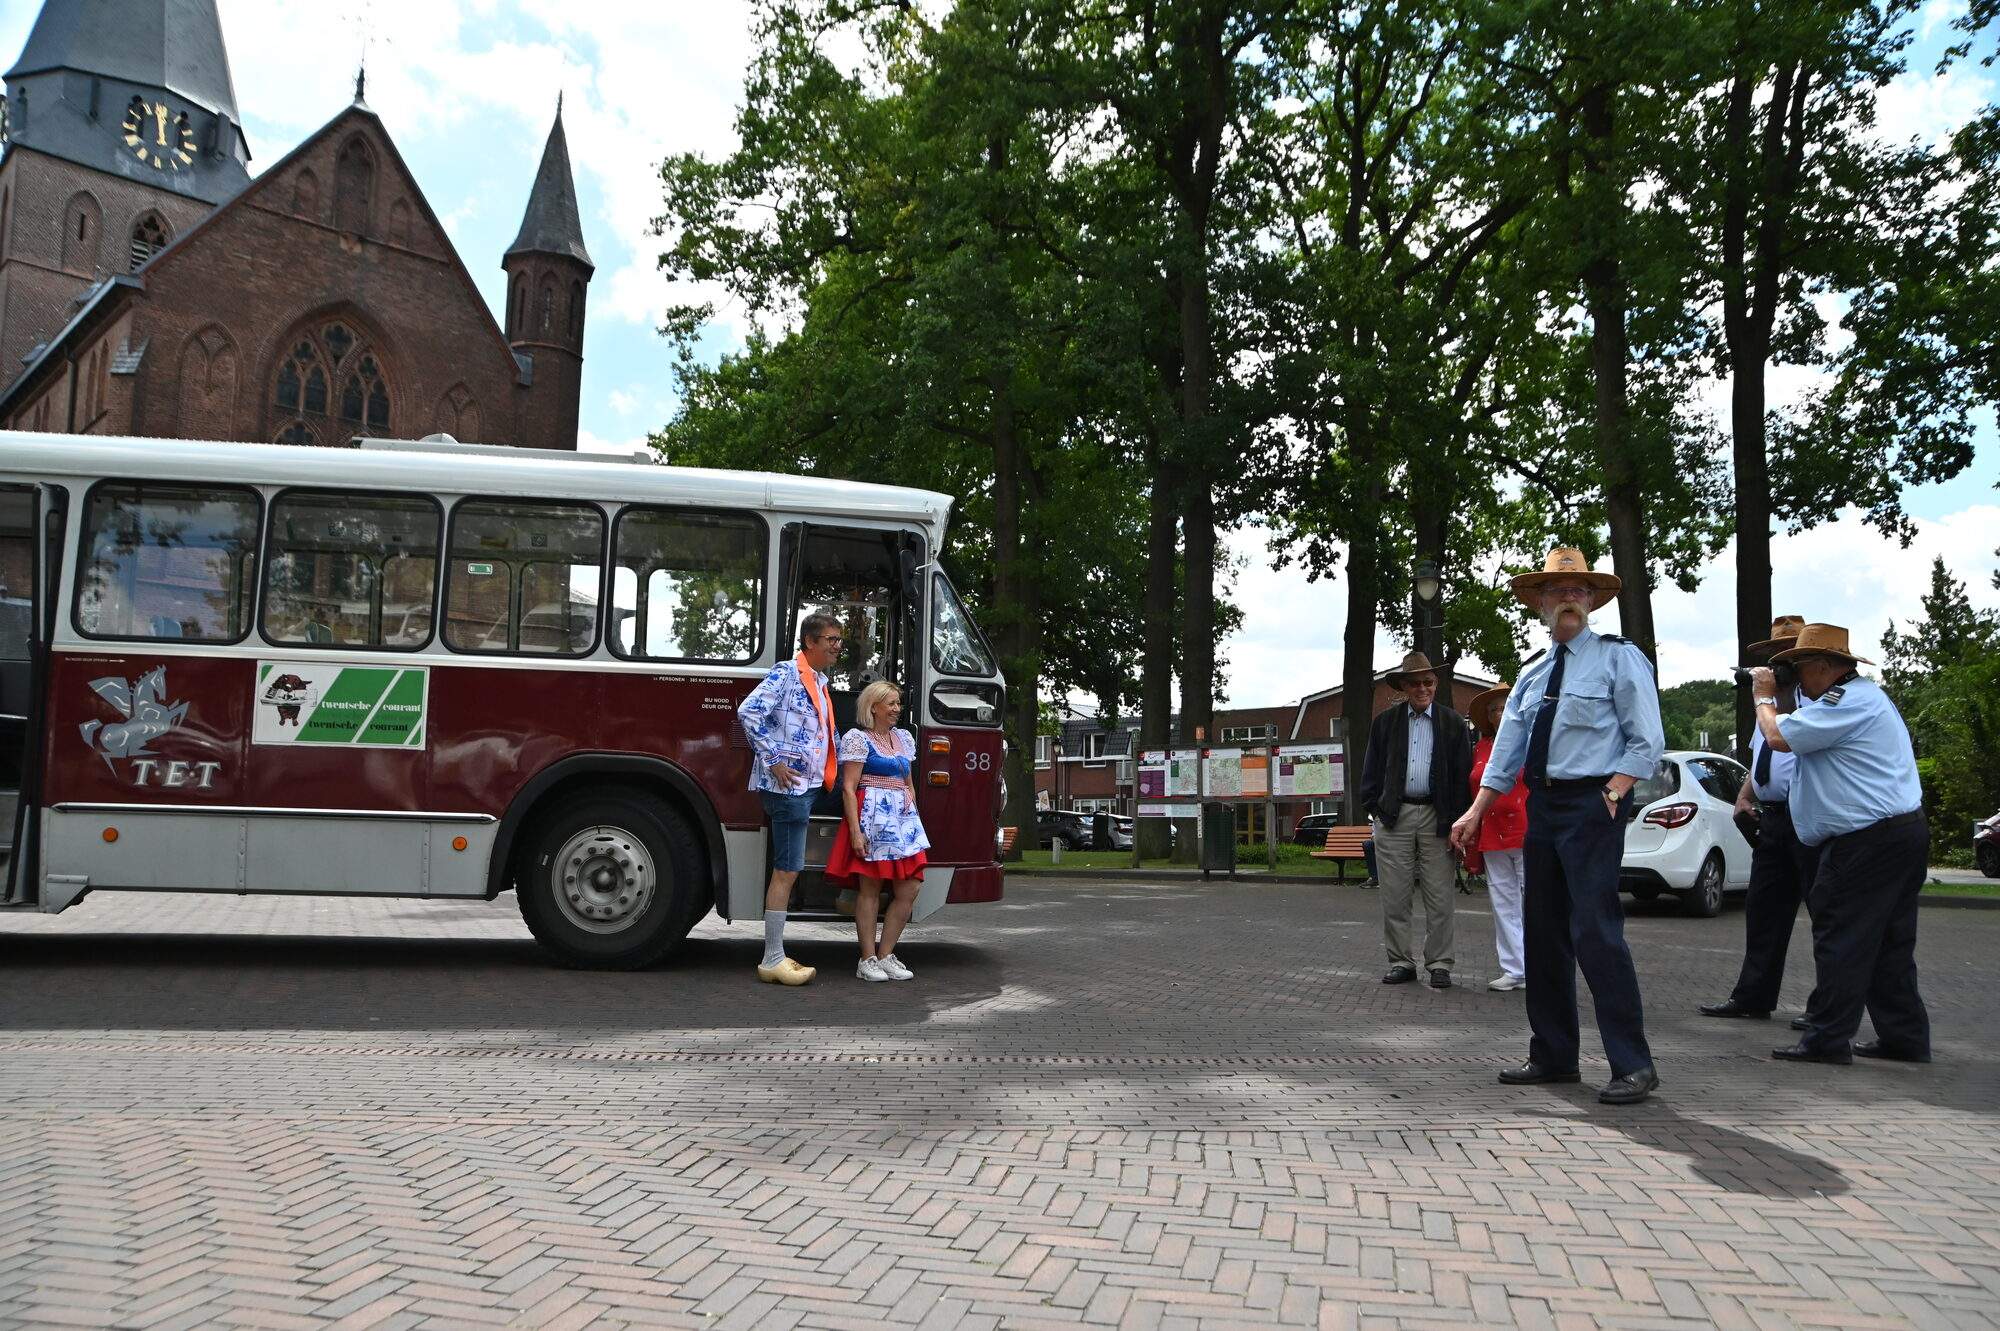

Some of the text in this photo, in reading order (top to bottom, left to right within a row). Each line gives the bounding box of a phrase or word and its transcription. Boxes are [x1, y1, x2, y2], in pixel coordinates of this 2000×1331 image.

[321, 701, 421, 712] twentsche courant
[964, 751, 990, 771] 38
